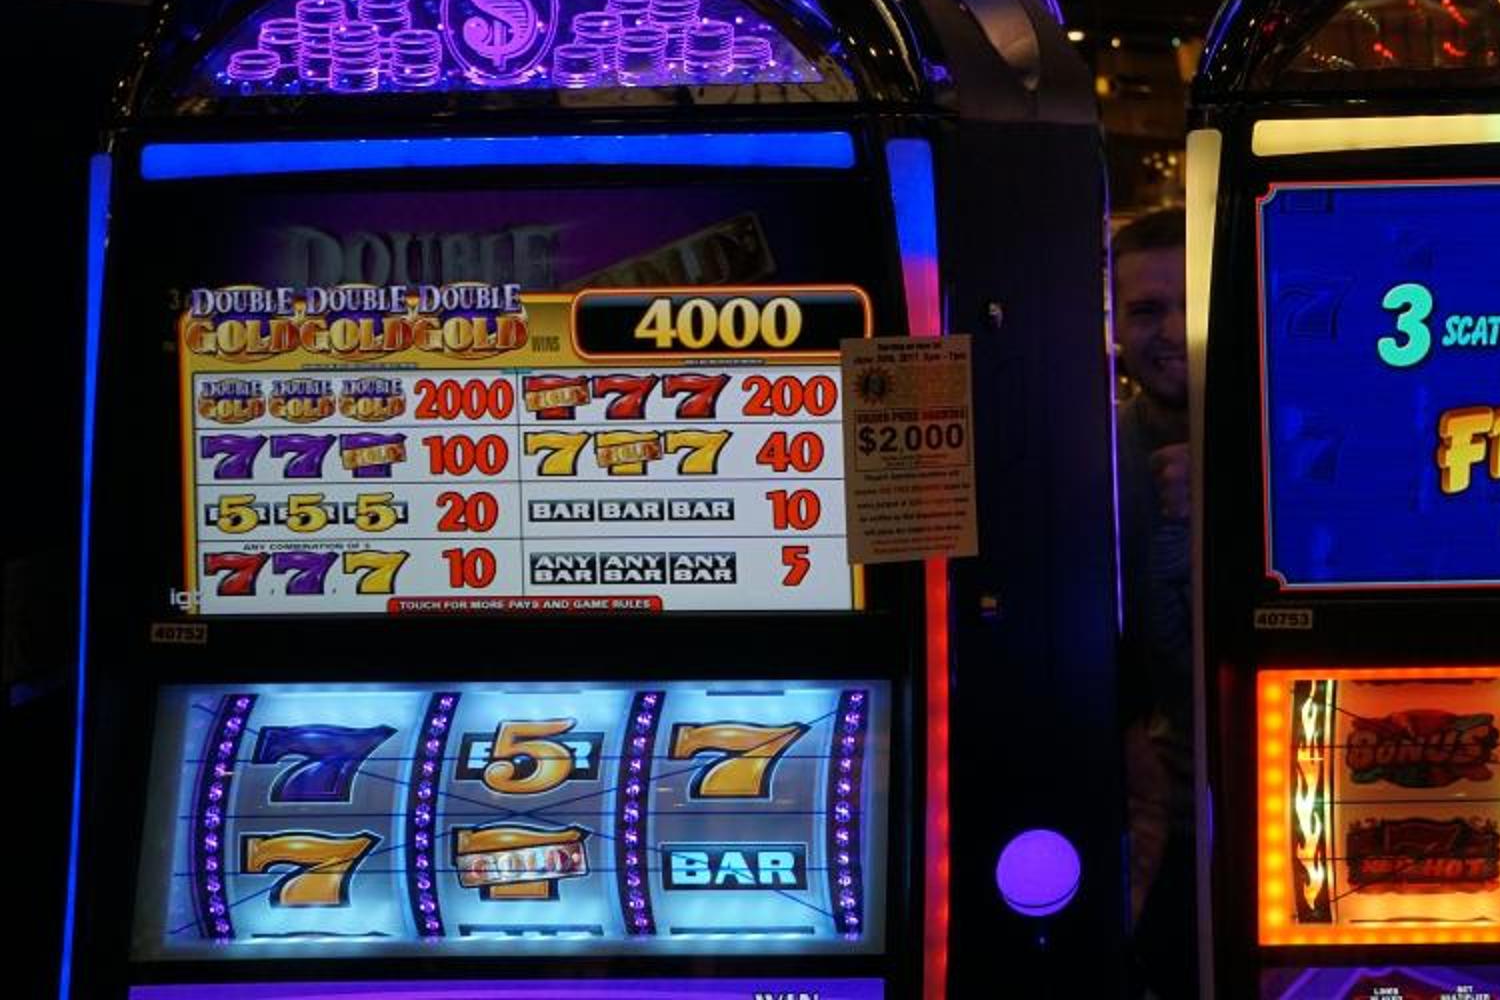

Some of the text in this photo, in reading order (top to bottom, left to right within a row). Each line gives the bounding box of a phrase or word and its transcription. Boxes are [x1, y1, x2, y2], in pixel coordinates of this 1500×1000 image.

[192, 284, 521, 315] DOUBLE DOUBLE DOUBLE
[187, 316, 561, 354] GOLD GOLD GOLD WINS
[634, 297, 802, 349] 4000
[1377, 284, 1433, 367] 3
[199, 396, 406, 418] GOLD GOLD GOLD
[201, 378, 514, 420] DOUBLE DOUBLE DOUBLE 2000
[741, 375, 838, 417] 200
[422, 434, 509, 476] 100
[756, 431, 824, 472] 40
[217, 492, 499, 534] 5 5 5 20
[532, 489, 821, 531] BAR BAR BAR 10
[442, 547, 496, 589] 10
[534, 570, 593, 581] BAR
[536, 556, 591, 569] ANY
[604, 570, 663, 581] BAR
[605, 555, 661, 568] ANY
[673, 569, 732, 581] BAR
[674, 555, 730, 568] ANY
[781, 546, 810, 586] 5
[400, 600, 649, 610] TOUCH FOR MORE PAYS AND GAME RULES
[252, 718, 811, 803] 7 5 7
[1348, 724, 1490, 771] BONUS
[240, 832, 382, 907] 7
[670, 850, 798, 886] BAR
